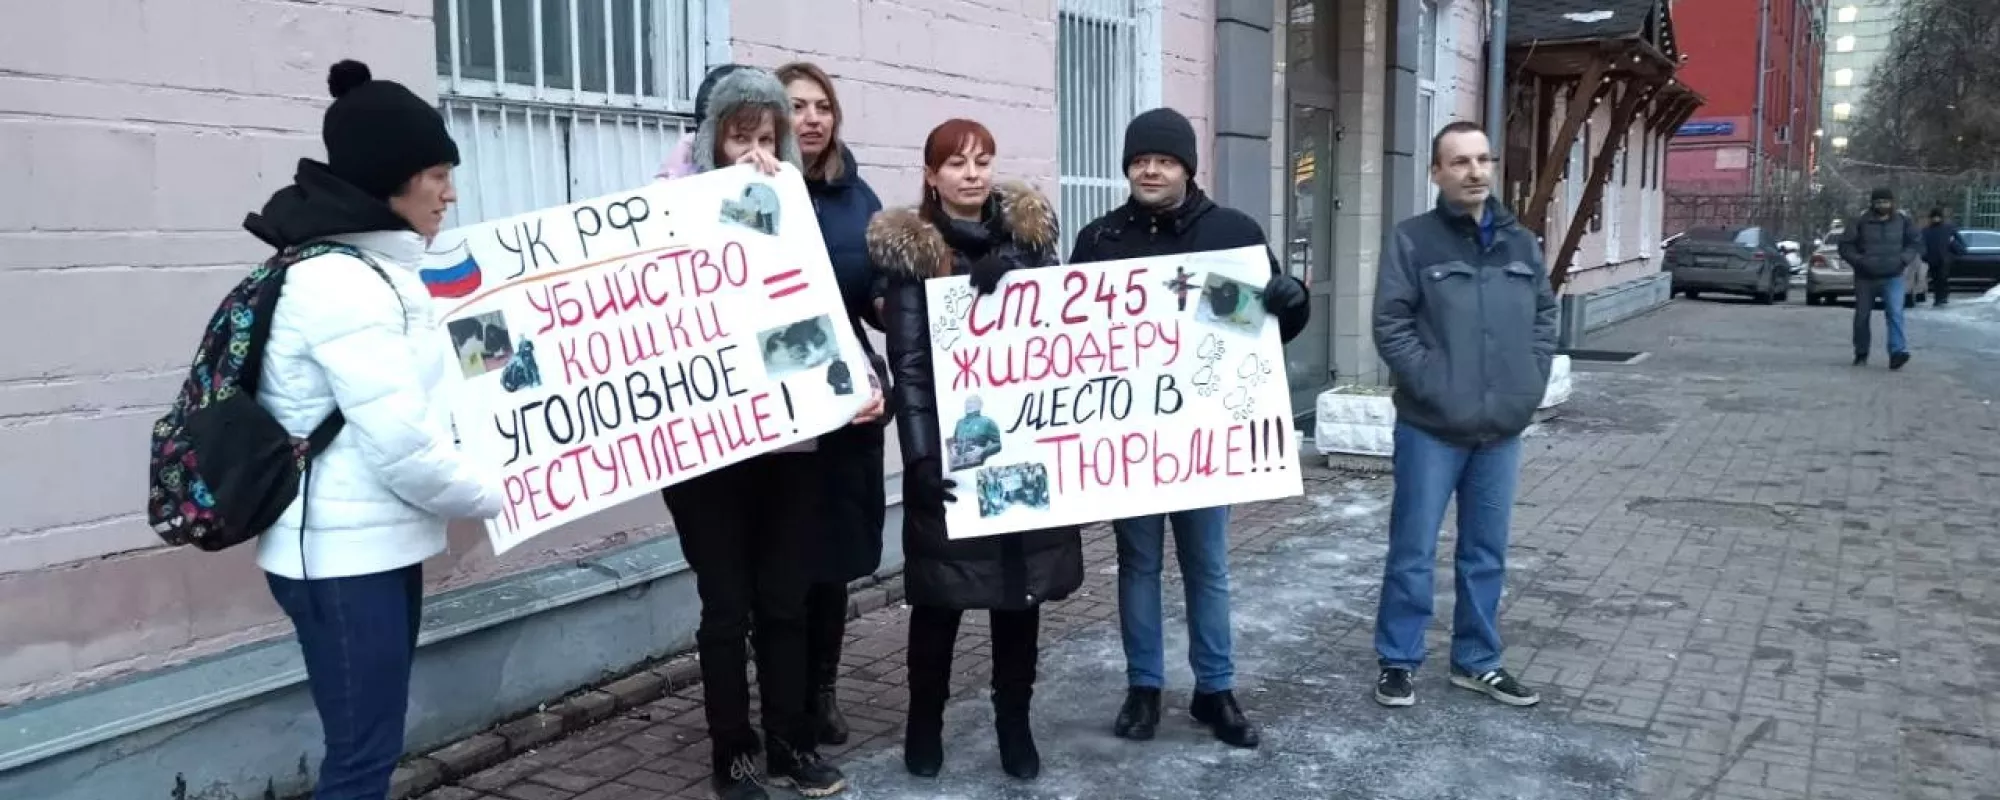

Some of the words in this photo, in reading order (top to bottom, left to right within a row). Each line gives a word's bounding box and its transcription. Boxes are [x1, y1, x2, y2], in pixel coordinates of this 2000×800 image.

[496, 218, 559, 279] УК
[526, 241, 748, 334] УБИЙСТВО
[1061, 268, 1149, 320] 245
[560, 302, 728, 384] КОШКИ
[952, 318, 1181, 391] ЖИВОДЁРУ
[494, 344, 749, 467] УГОЛОВНОЕ
[1005, 375, 1133, 434] МЕСТО
[1154, 374, 1184, 416] В
[500, 382, 800, 534] РЕСТУПЛЕНИЕ!
[1034, 415, 1287, 496] ТЮРЬМЕ!!!
